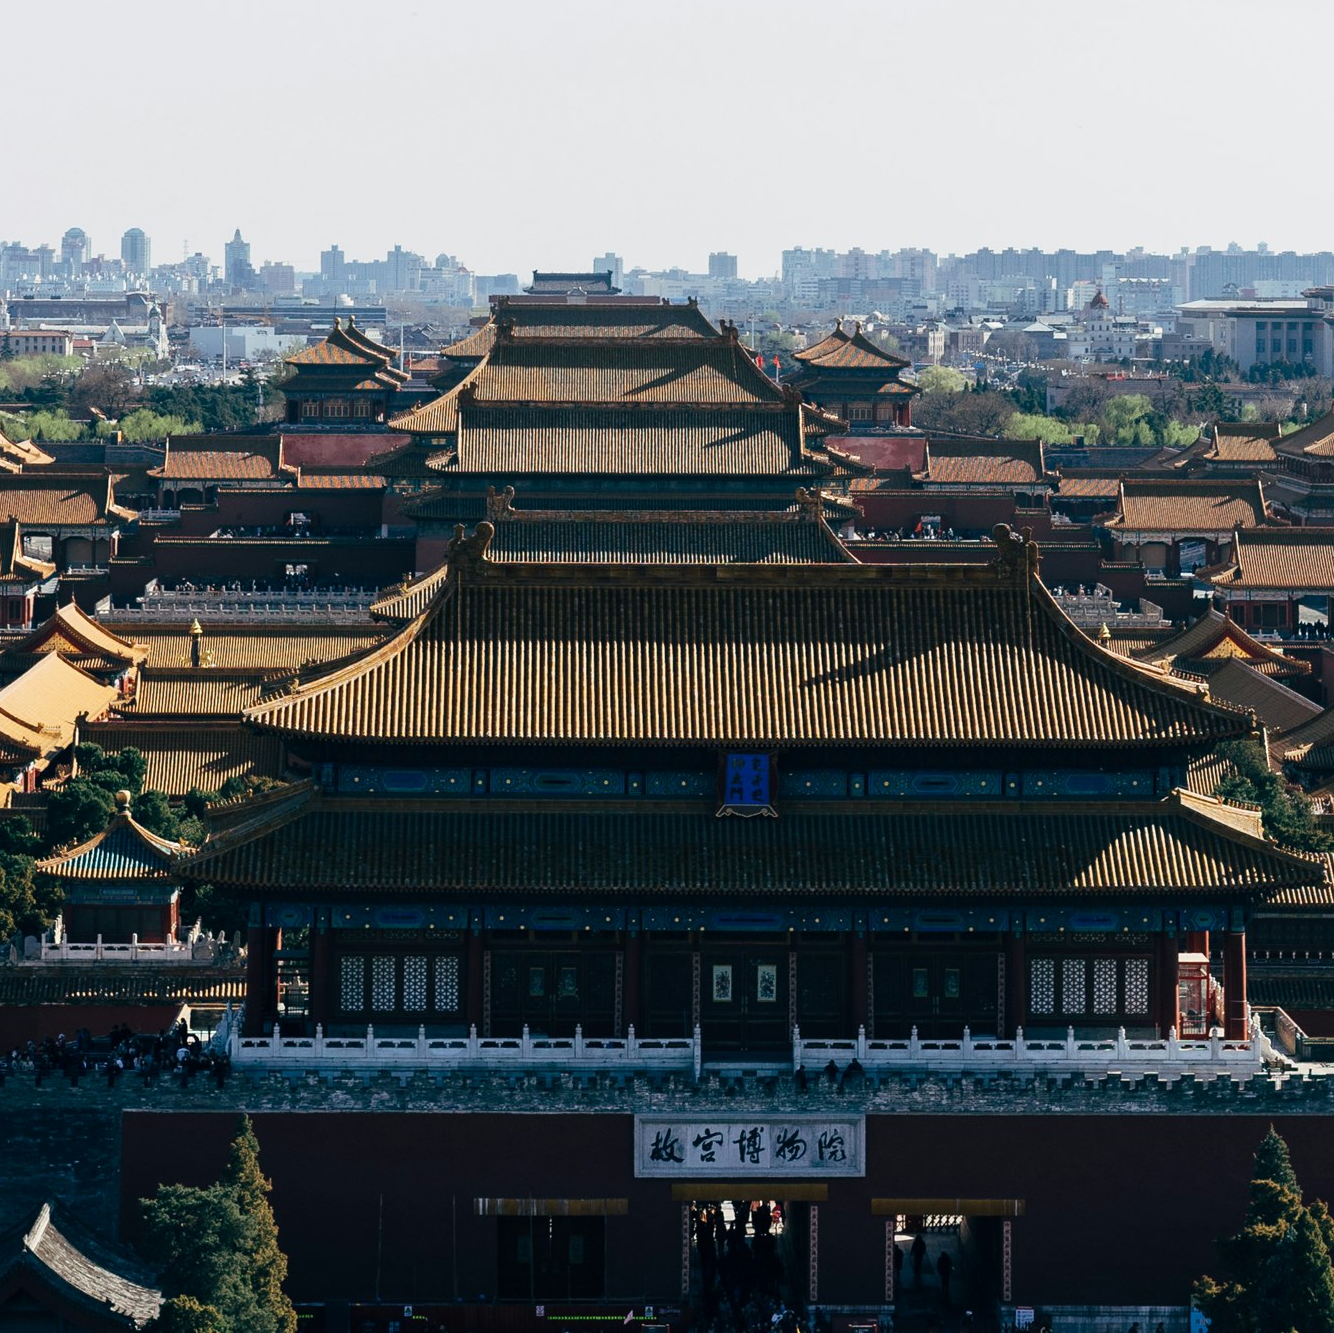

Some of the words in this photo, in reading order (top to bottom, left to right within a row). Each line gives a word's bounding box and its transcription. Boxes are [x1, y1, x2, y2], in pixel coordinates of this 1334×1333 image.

[650, 1127, 846, 1163] 故宫博物院
